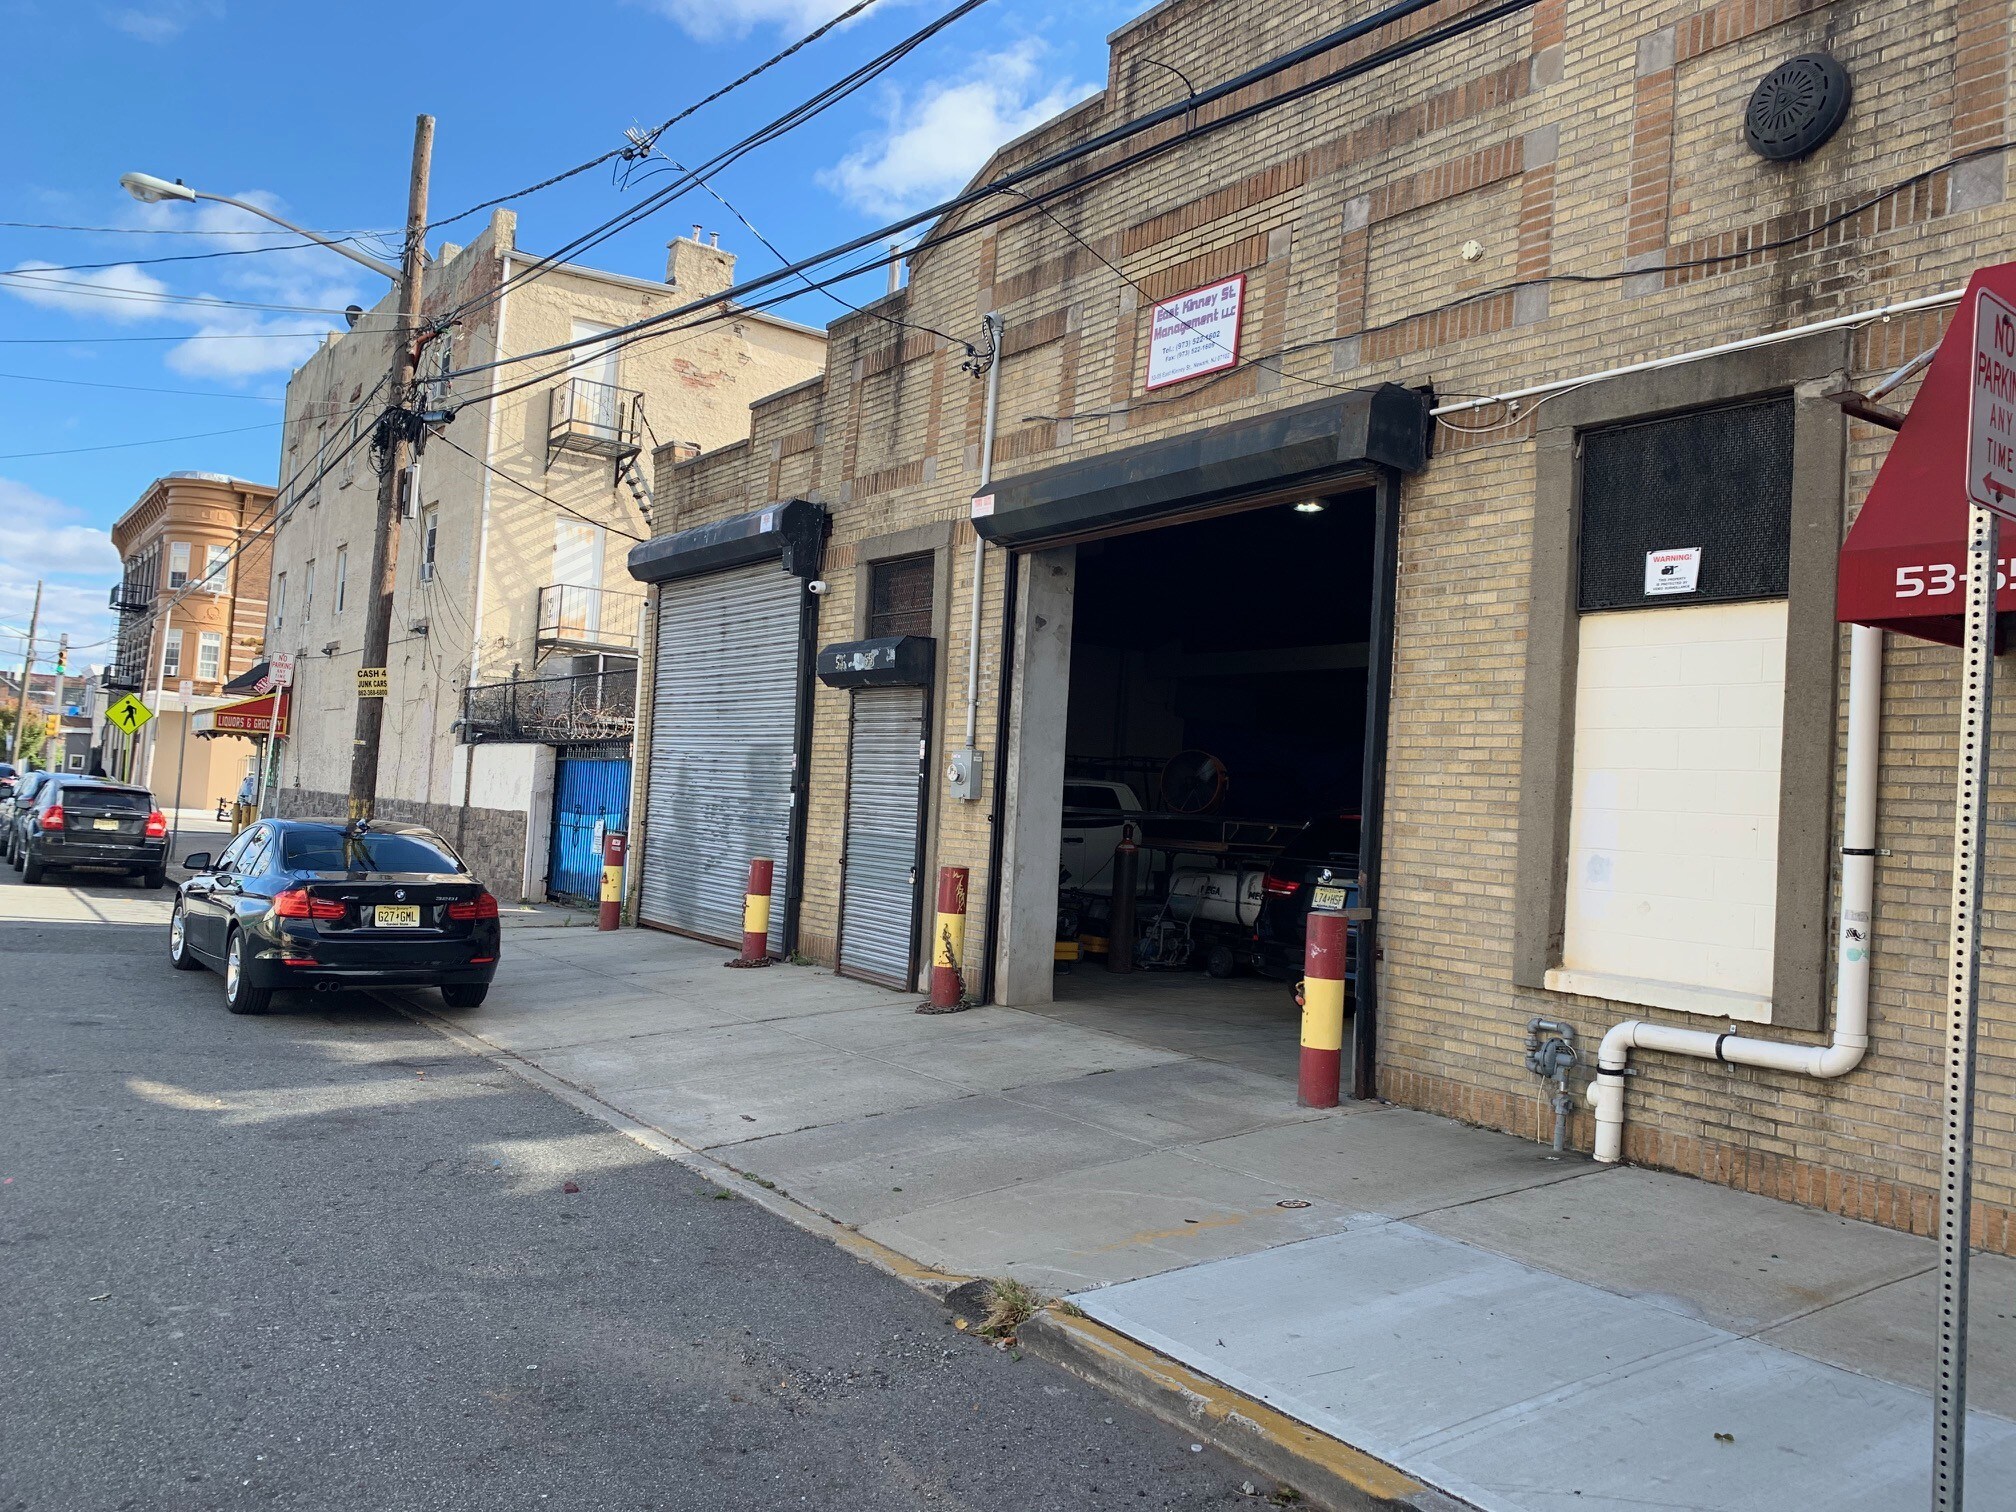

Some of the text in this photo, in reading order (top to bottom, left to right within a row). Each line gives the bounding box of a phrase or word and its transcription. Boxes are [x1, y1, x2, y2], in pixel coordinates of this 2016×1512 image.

[1157, 305, 1179, 322] East
[1182, 293, 1218, 314] Kinney
[1154, 305, 1237, 341] Management LLC
[1994, 313, 2015, 358] NO
[1175, 339, 1190, 351] (973)
[1978, 351, 2016, 405] PARKIN
[1989, 402, 2013, 436] ANY
[1987, 436, 2014, 474] TIME
[1653, 554, 1692, 562] WARNING!
[271, 661, 293, 670] PARKING
[279, 654, 287, 662] NO
[218, 715, 282, 730] LIQUORS & GROCY
